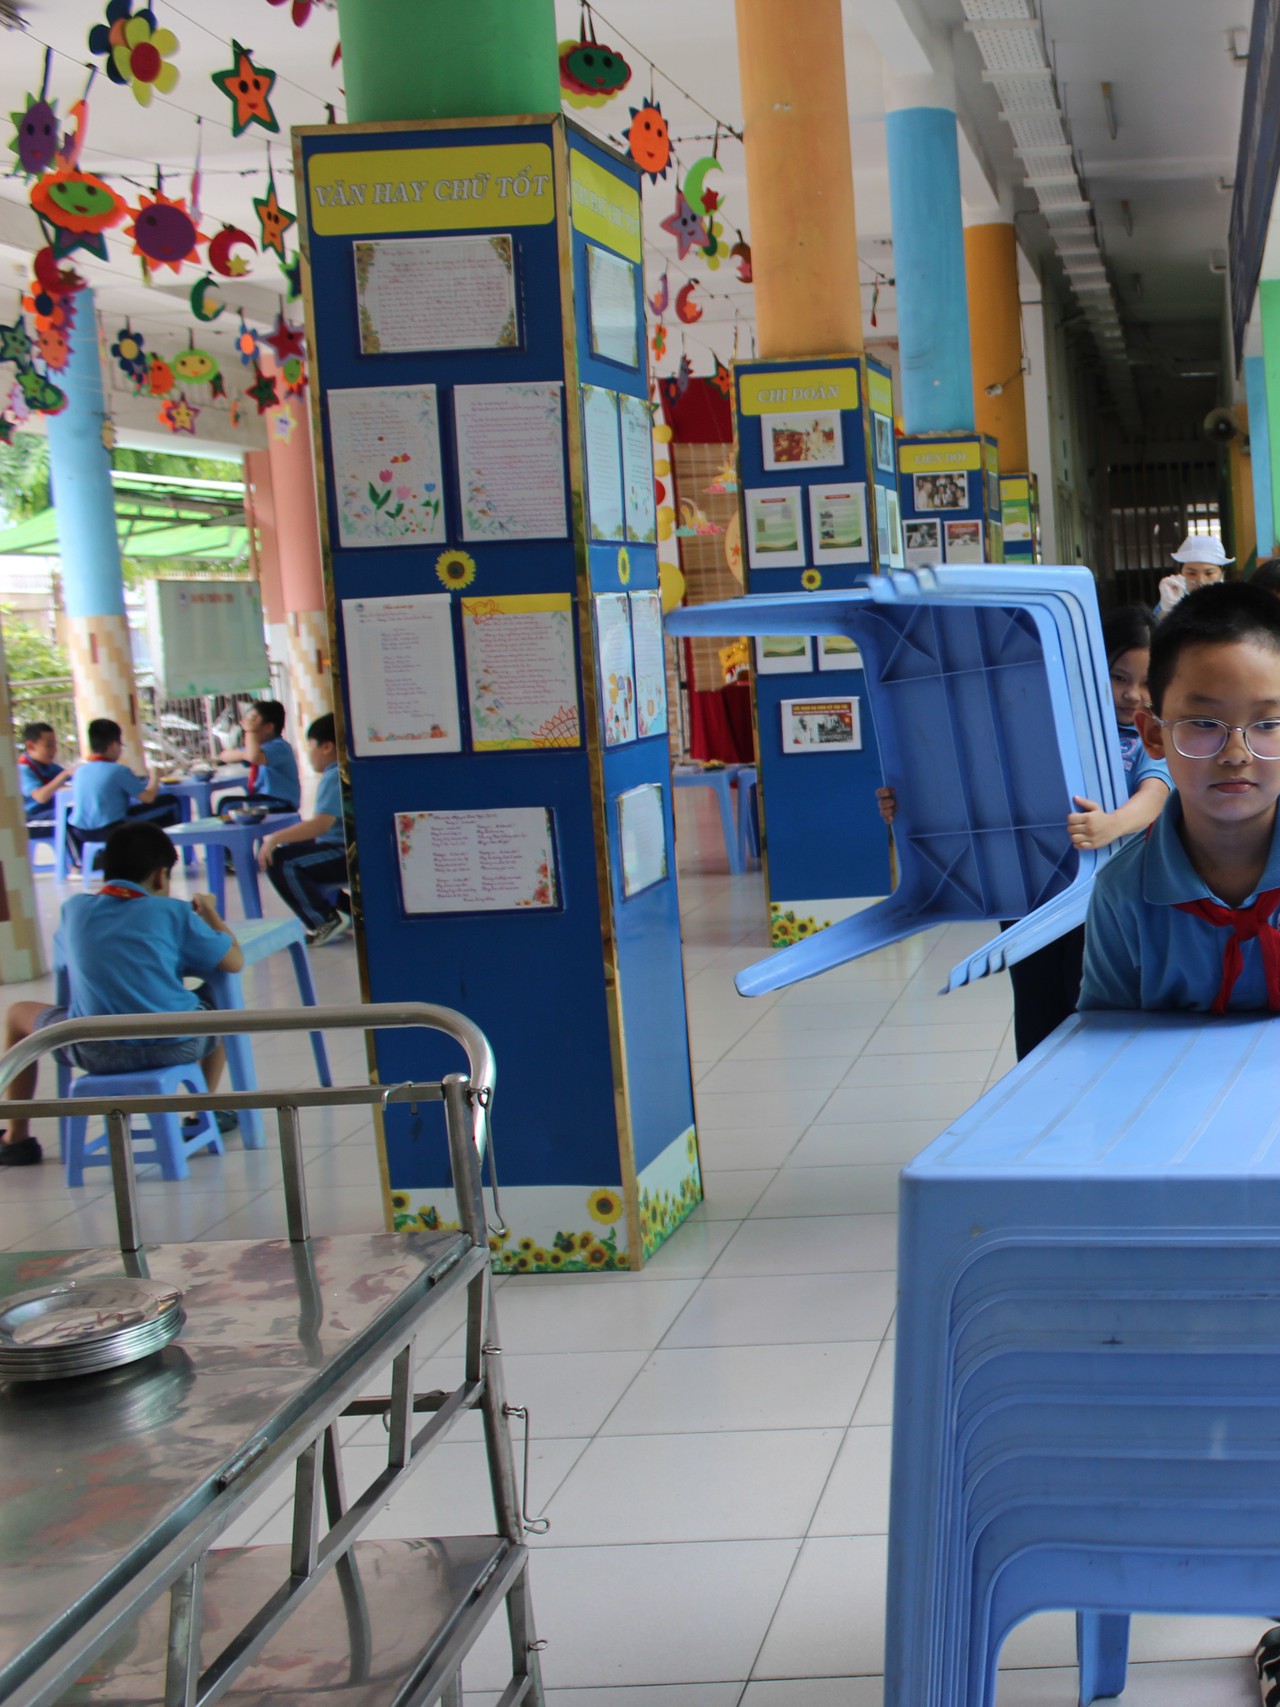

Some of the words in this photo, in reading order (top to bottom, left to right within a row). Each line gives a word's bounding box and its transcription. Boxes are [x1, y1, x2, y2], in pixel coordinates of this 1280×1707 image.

[315, 179, 367, 207] VĂN
[372, 180, 428, 205] HAY
[434, 171, 491, 201] CHỮ
[495, 164, 549, 199] TỐT
[758, 388, 787, 403] CHI
